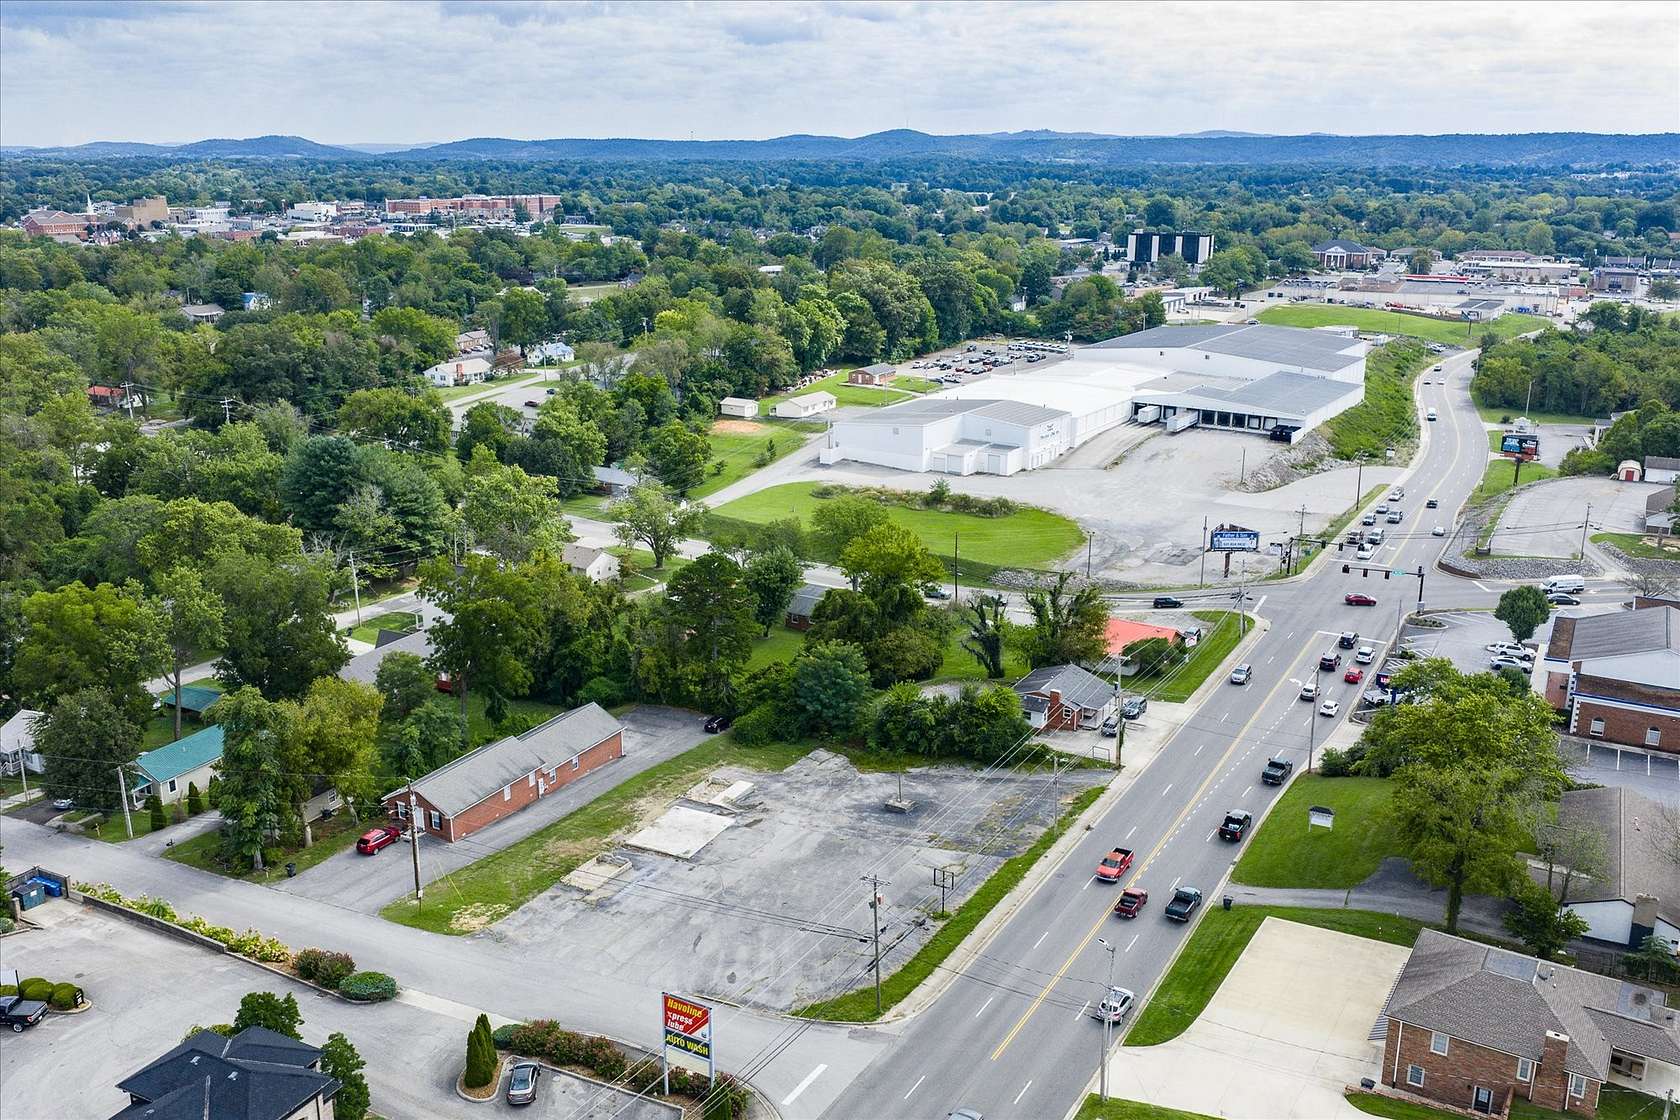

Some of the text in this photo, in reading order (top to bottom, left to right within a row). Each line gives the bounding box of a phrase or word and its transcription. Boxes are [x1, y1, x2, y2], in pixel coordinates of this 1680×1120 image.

[667, 999, 702, 1017] Havoline
[667, 1019, 684, 1031] lube
[666, 1034, 708, 1055] AUTO WASH
